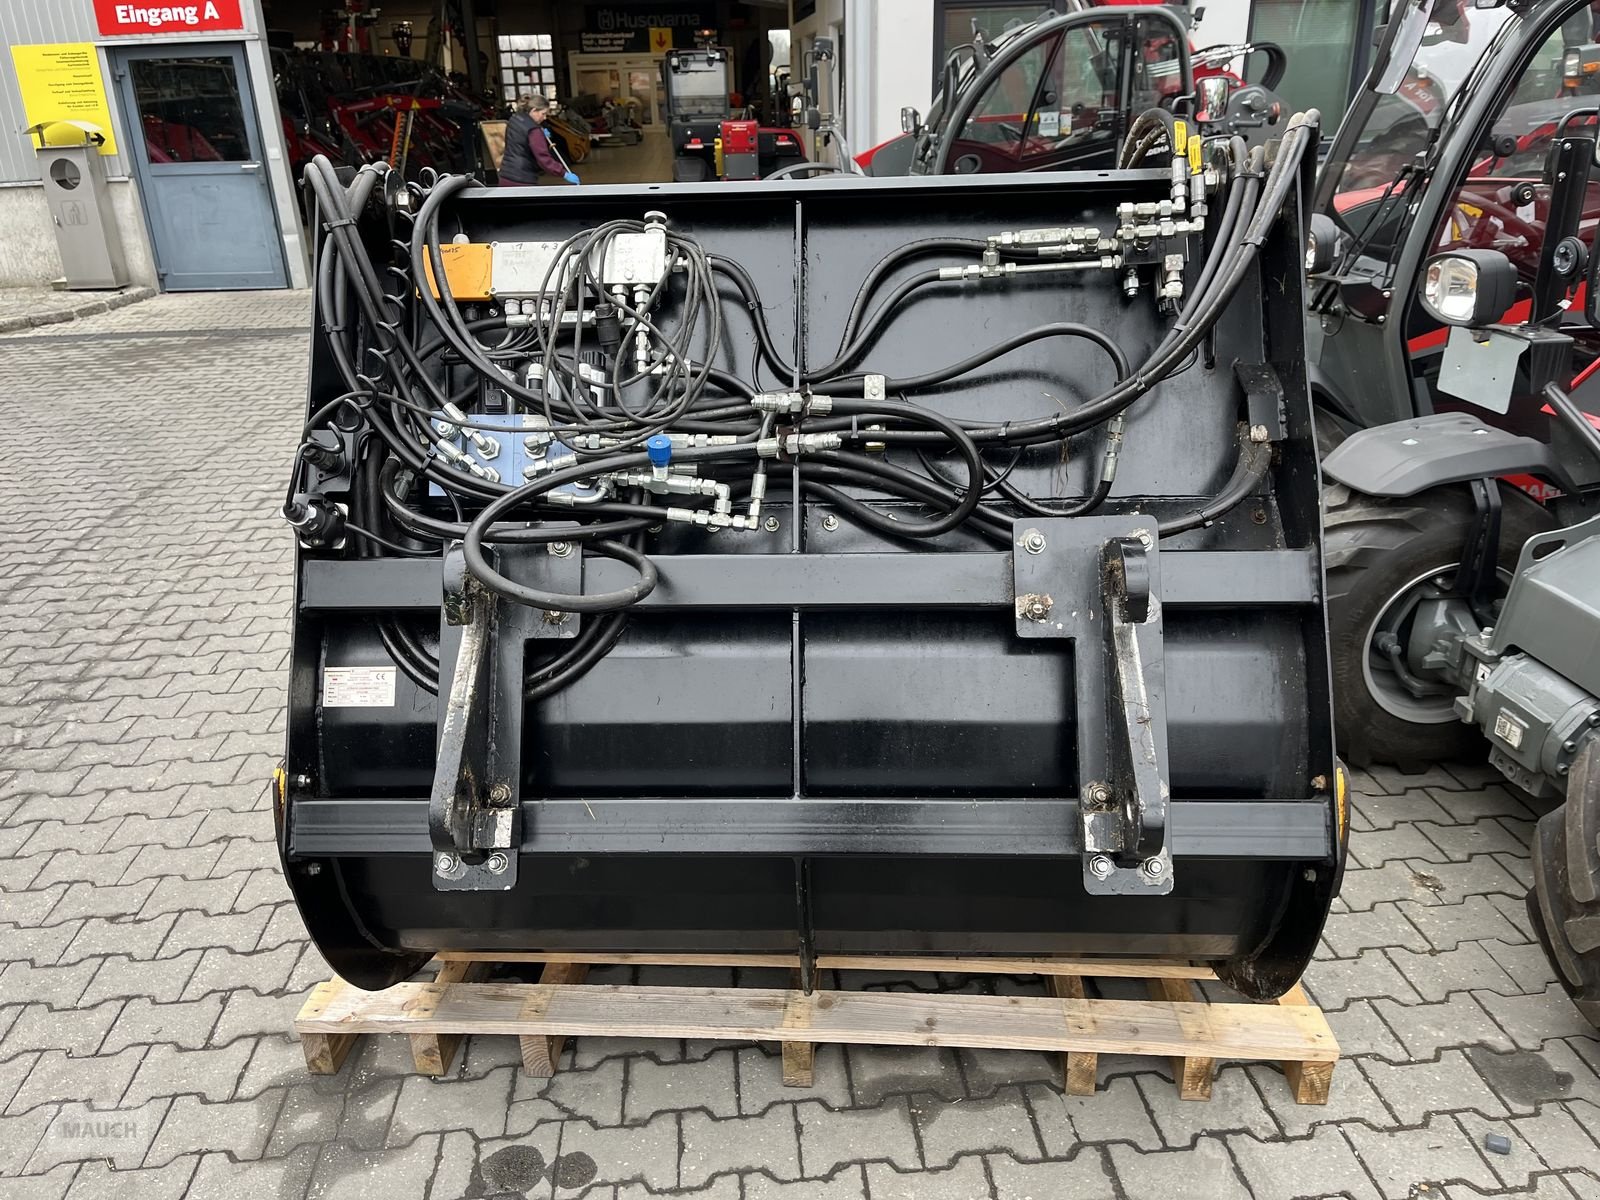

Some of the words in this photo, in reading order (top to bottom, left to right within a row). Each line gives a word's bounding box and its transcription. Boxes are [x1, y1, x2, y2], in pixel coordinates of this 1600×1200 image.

[115, 4, 199, 26] Eingang
[204, 1, 220, 19] A
[616, 12, 700, 29] Husqvarna
